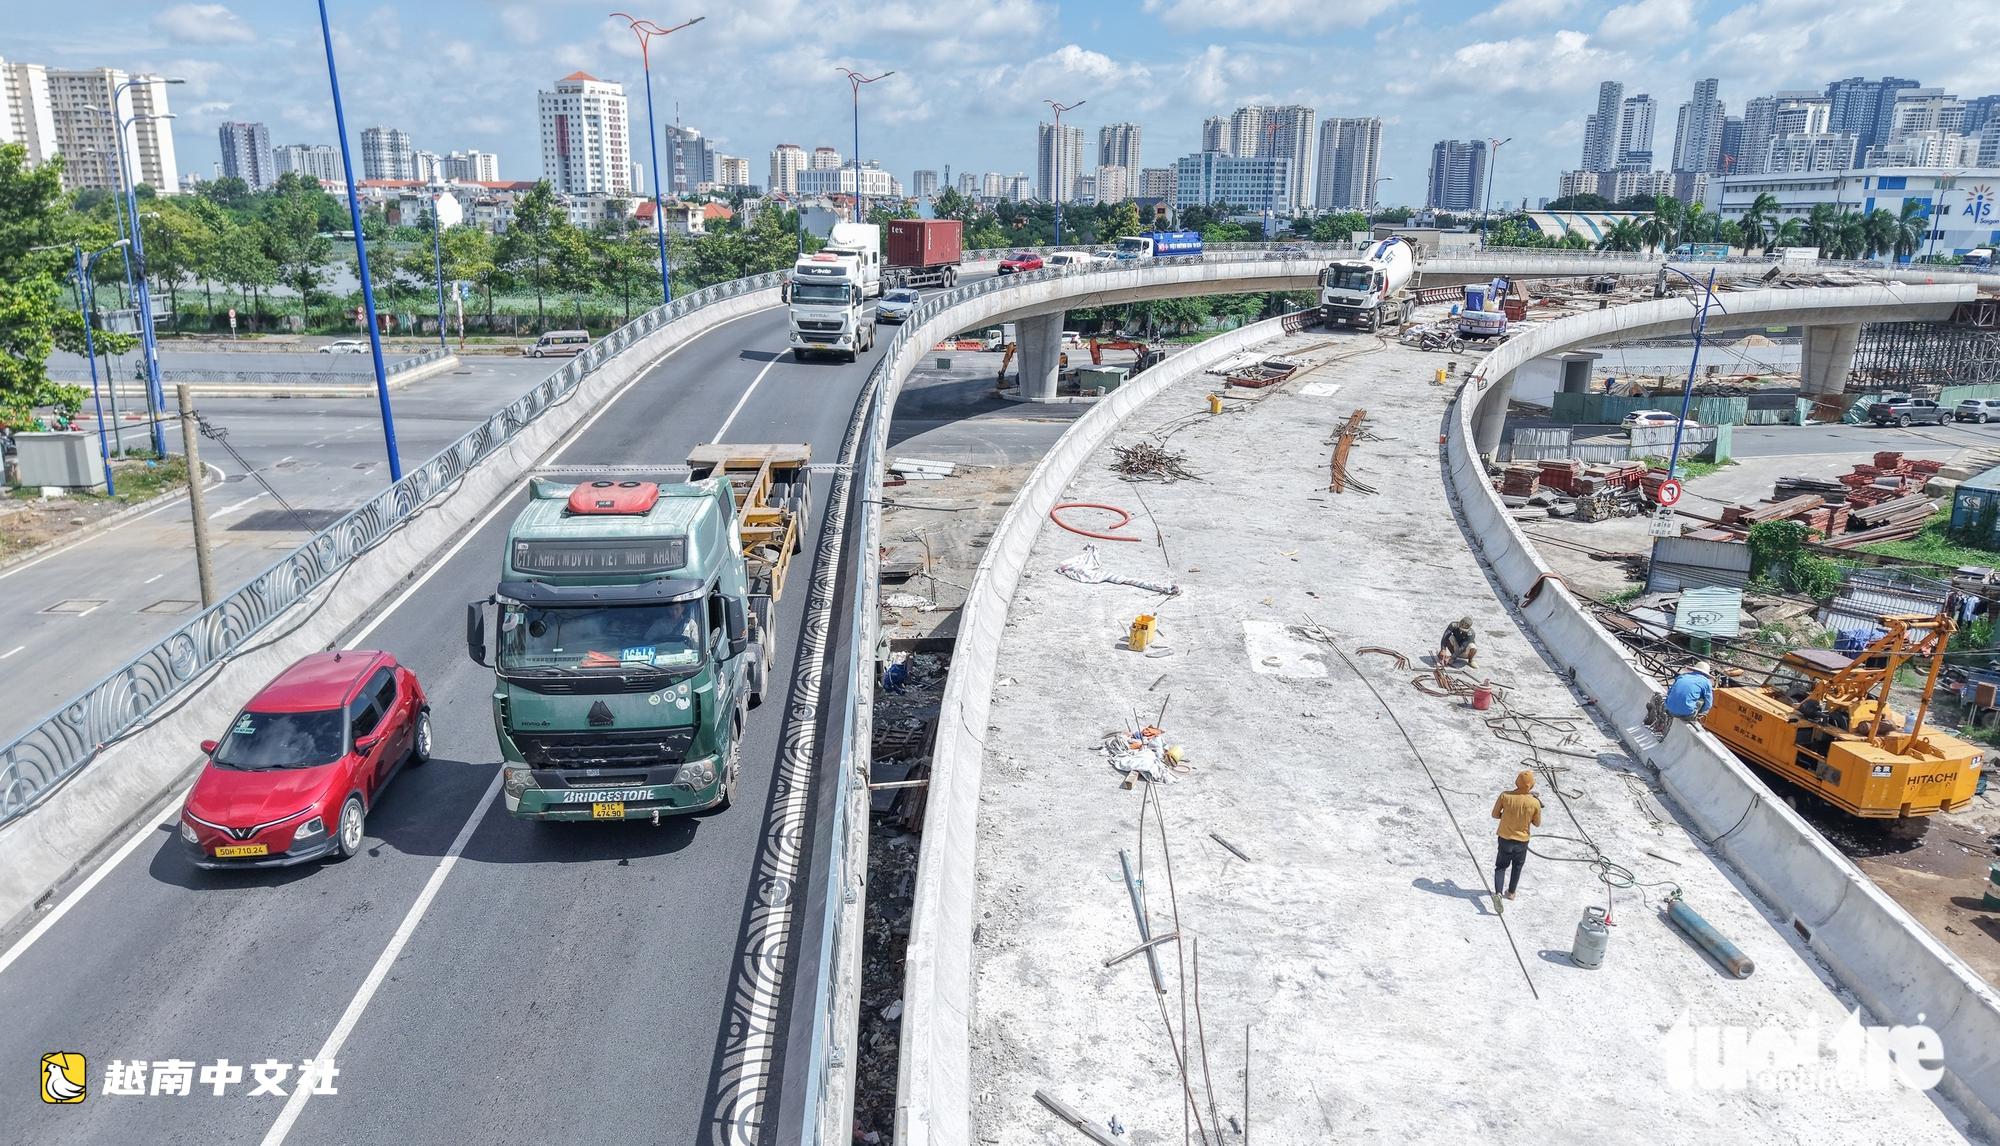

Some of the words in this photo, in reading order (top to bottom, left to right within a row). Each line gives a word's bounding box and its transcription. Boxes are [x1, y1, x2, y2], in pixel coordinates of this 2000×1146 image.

[1979, 217, 2000, 226] Saigon
[891, 226, 904, 234] tex
[1906, 772, 1958, 786] HITACHI
[563, 788, 656, 803] BRIDGESTONE
[601, 803, 616, 811] 51C
[596, 810, 622, 818] 474.90
